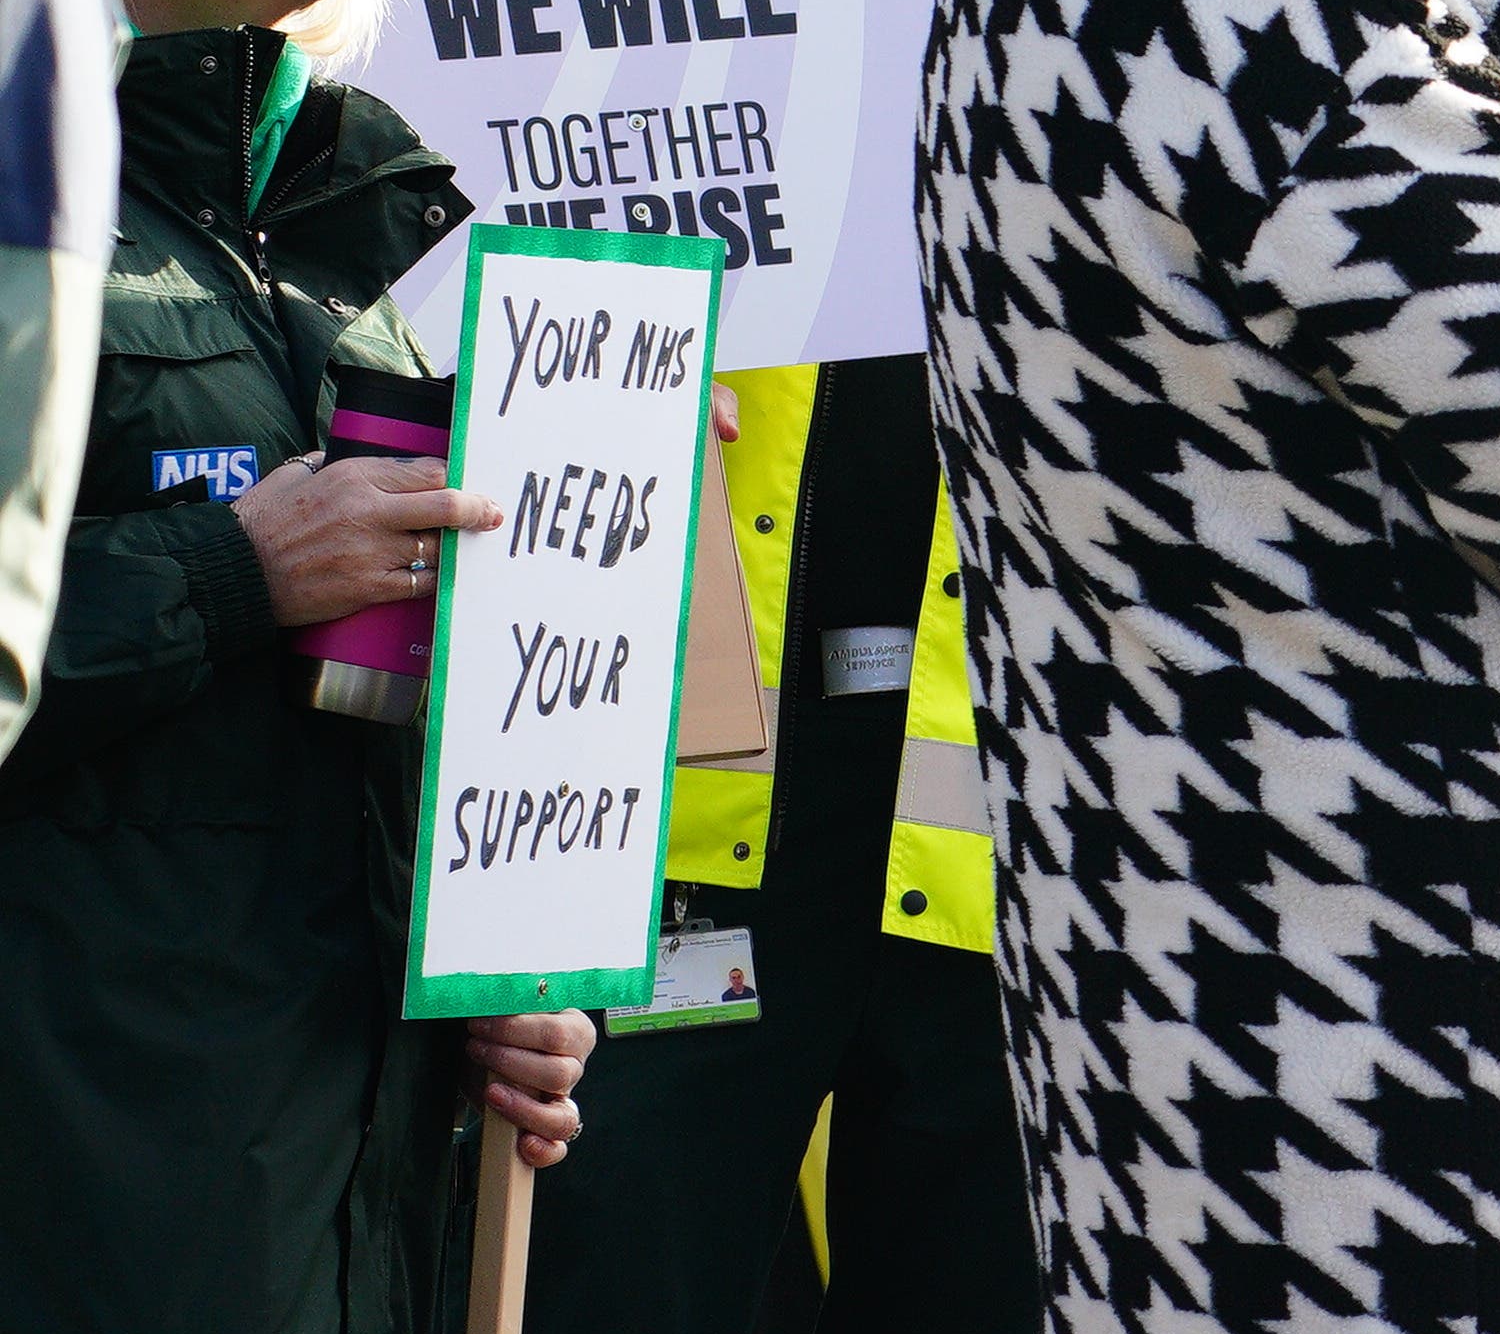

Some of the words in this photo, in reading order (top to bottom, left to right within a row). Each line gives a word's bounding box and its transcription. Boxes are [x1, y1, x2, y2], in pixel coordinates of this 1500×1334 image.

[487, 100, 776, 193] TOGETHER
[498, 295, 612, 418] YOUR
[621, 319, 696, 393] NHS
[158, 451, 254, 496] NHS
[509, 463, 657, 569] NEEDS
[501, 622, 629, 734] YOUR
[449, 786, 640, 873] SUPPORT
